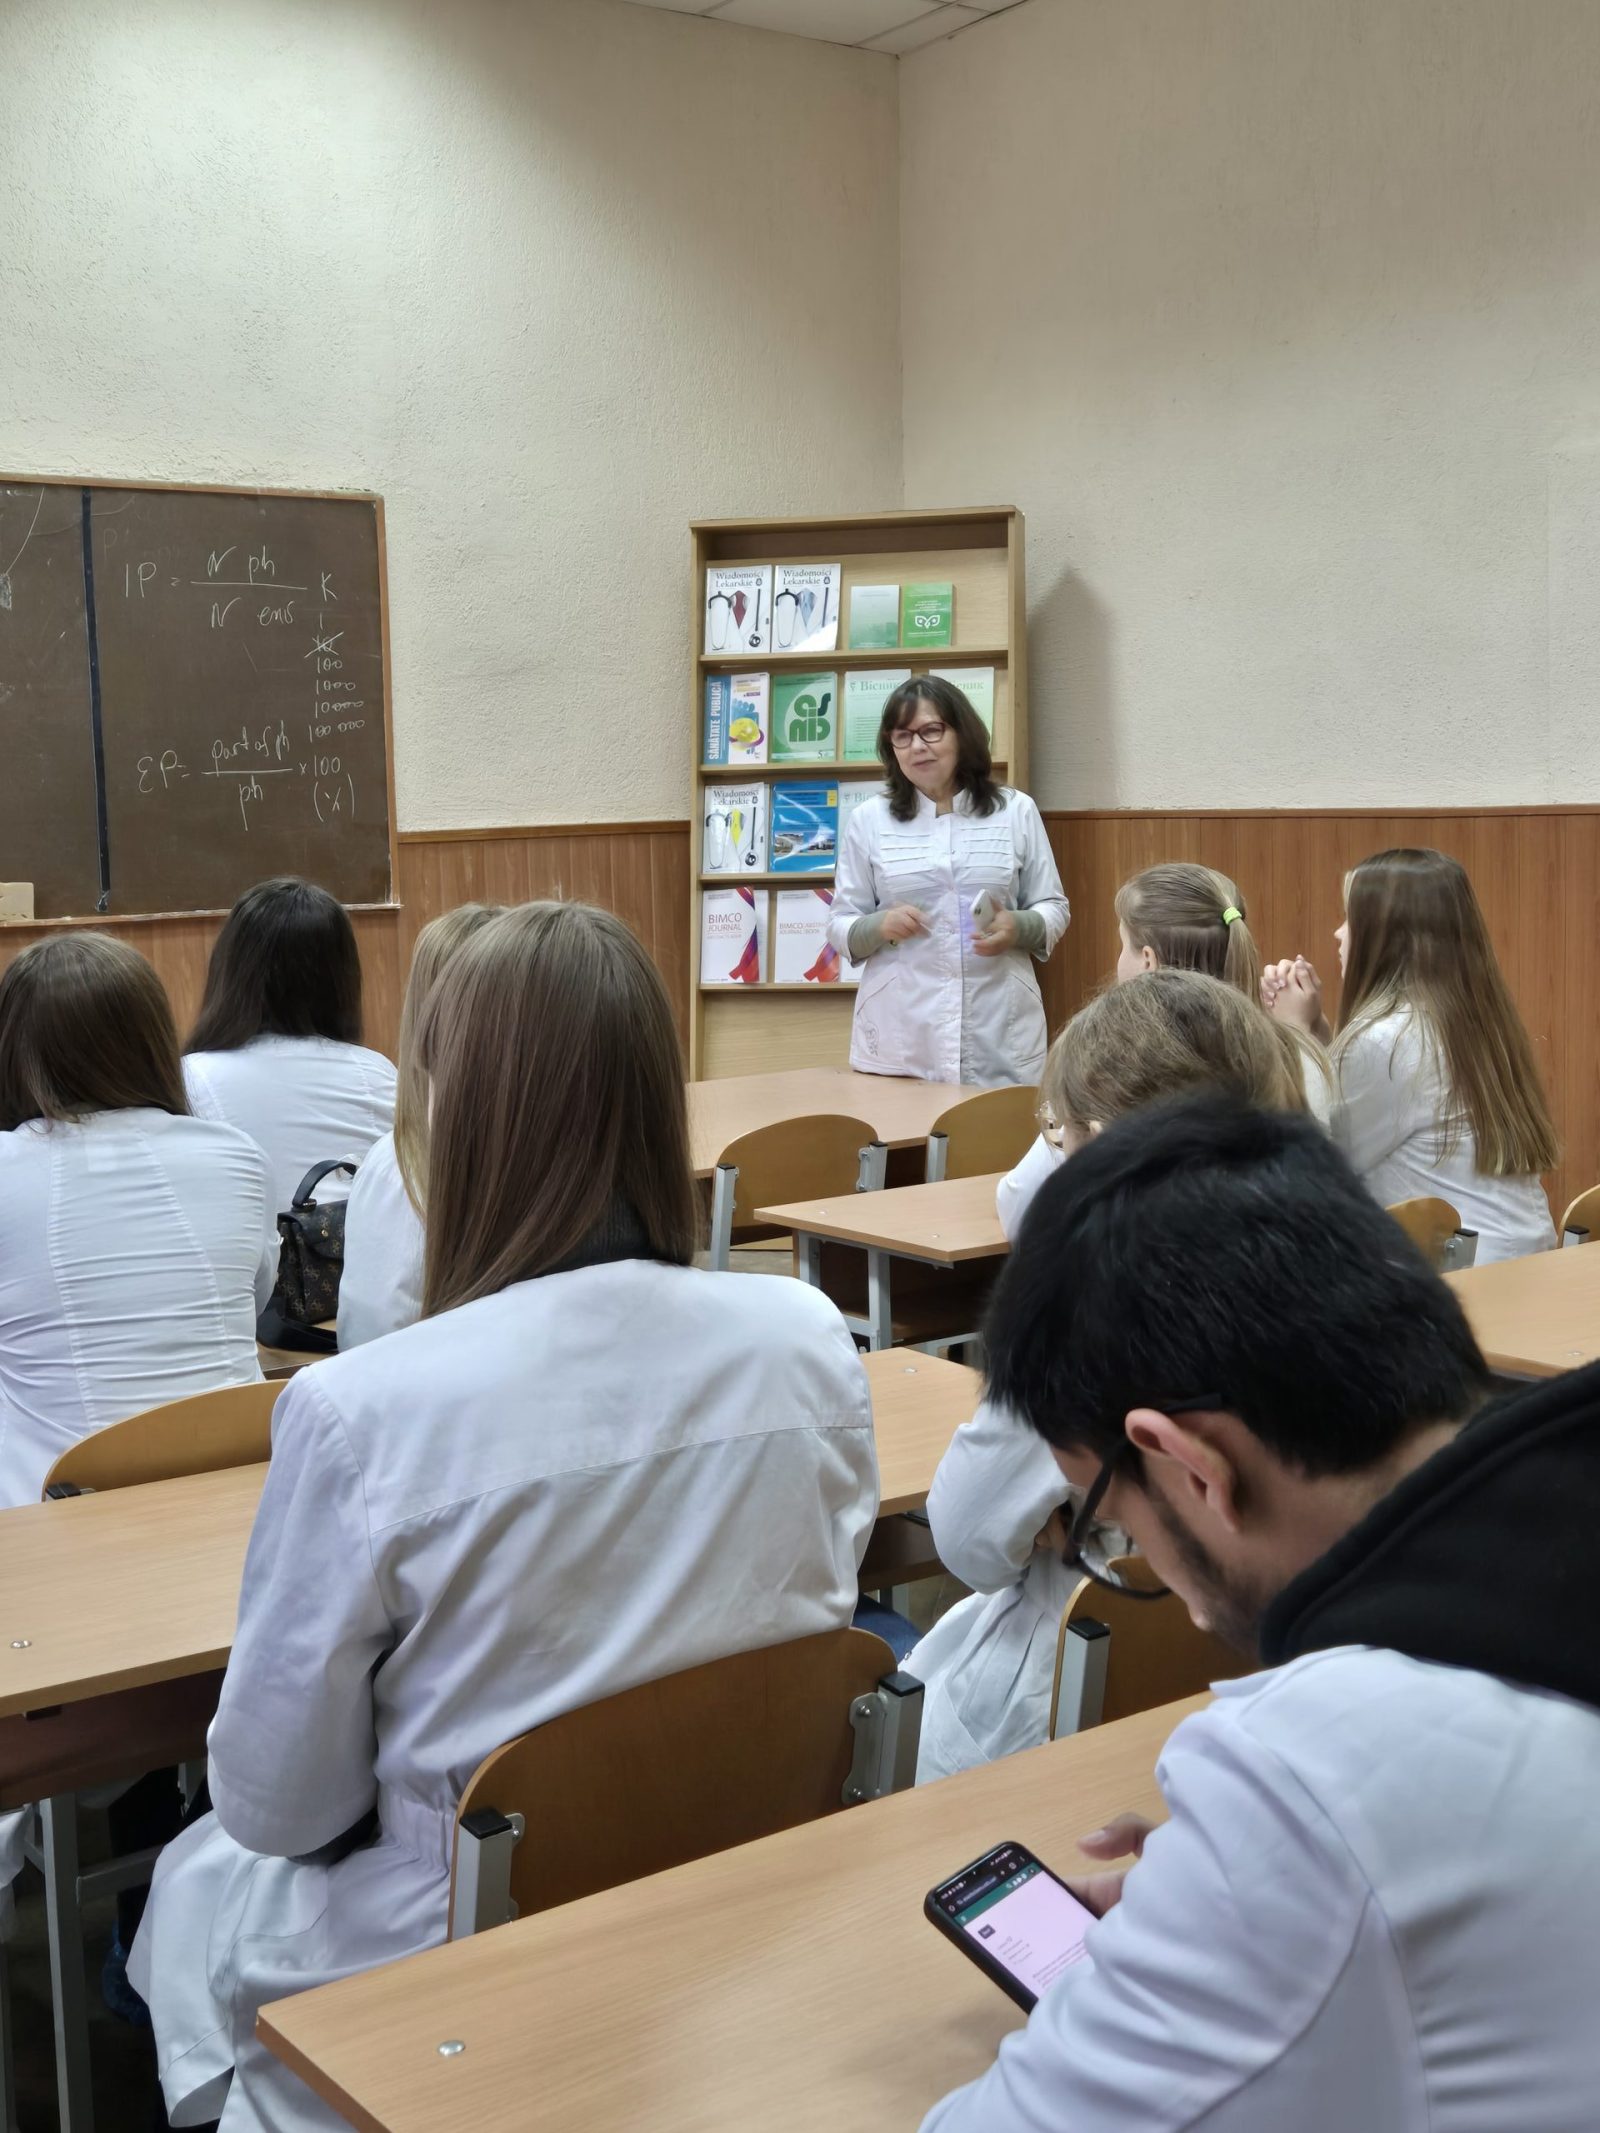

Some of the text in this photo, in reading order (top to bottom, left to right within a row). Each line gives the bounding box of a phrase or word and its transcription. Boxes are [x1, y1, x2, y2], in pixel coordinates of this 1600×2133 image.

[248, 545, 275, 584] ph
[783, 567, 832, 578] Wiadomości
[716, 579, 754, 588] Lekarskie
[783, 577, 821, 586] Lekarskie
[317, 656, 343, 674] 100
[239, 775, 264, 831] ph
[708, 912, 742, 924] BIMCO
[707, 923, 742, 932] JOURNAL
